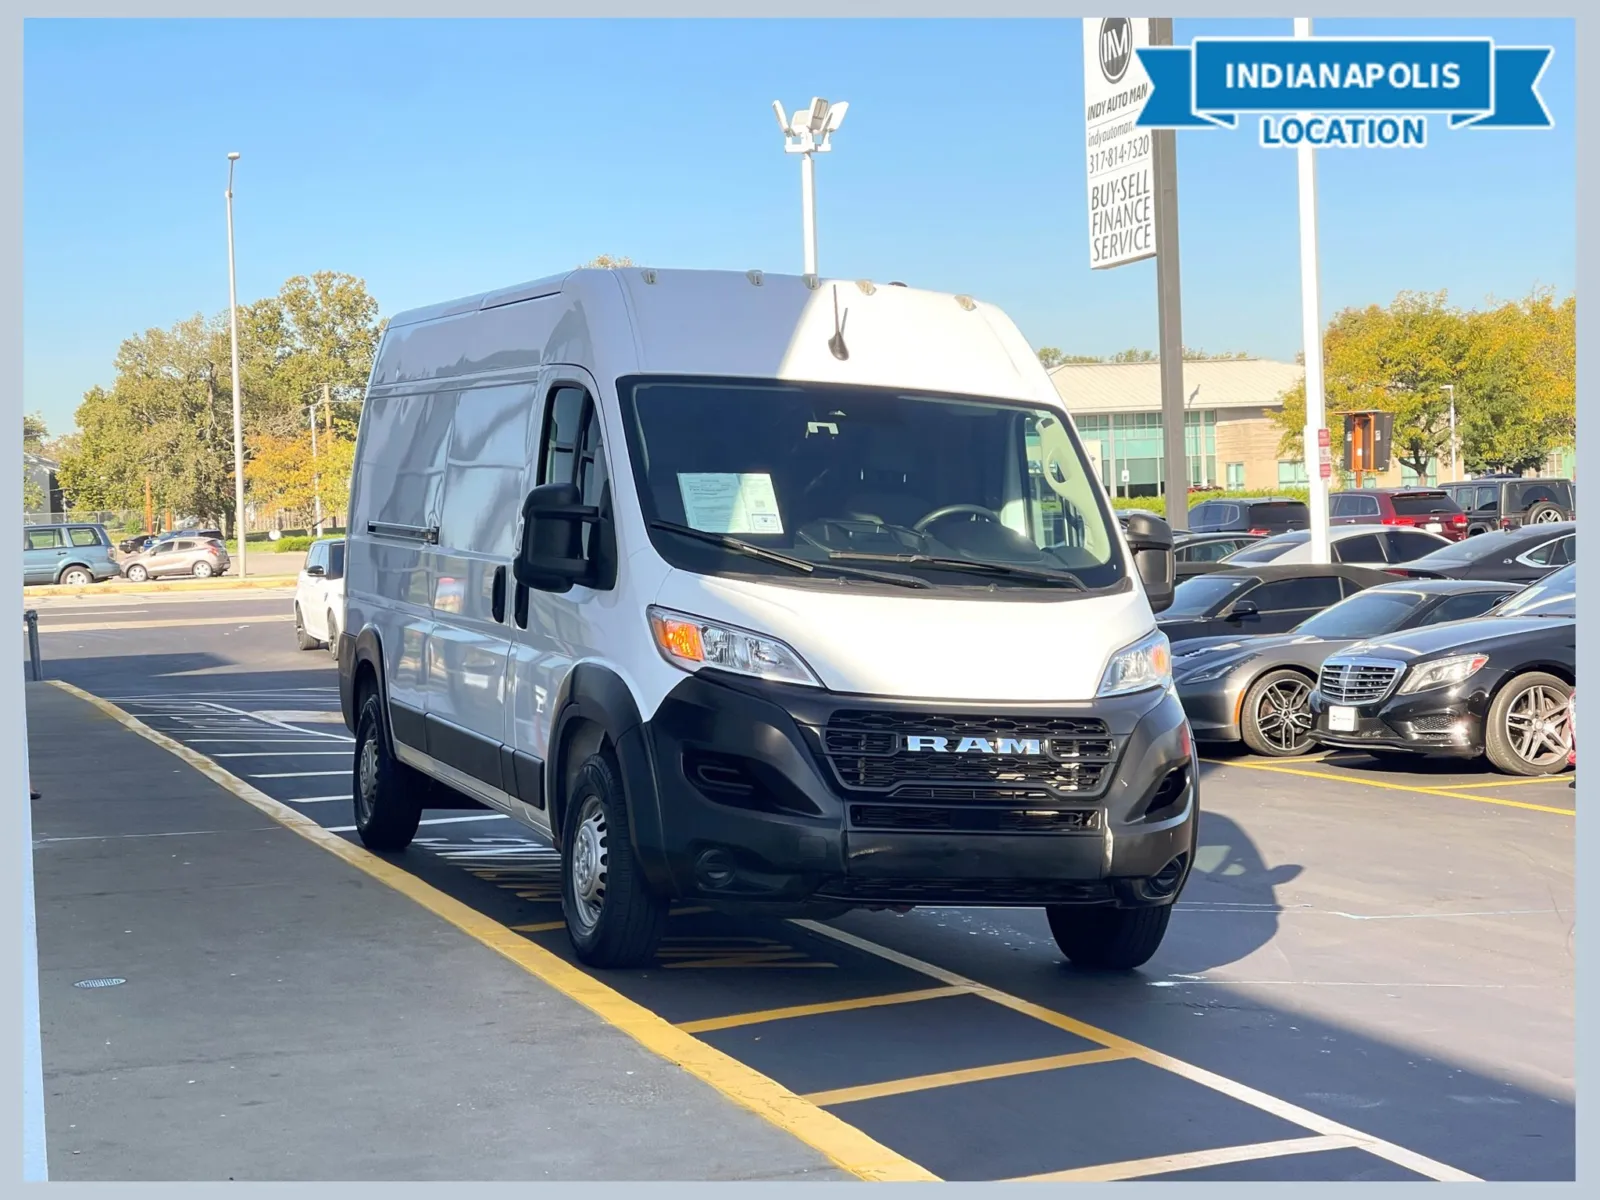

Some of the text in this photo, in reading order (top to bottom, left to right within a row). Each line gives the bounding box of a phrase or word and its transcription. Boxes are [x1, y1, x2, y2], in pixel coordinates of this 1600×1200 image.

[1087, 82, 1148, 121] INDY AUTO MAN
[1088, 121, 1136, 148] indyautoman.
[1092, 196, 1151, 237] FINANCE
[1093, 223, 1151, 262] SERVICE
[907, 735, 1040, 755] RAM
